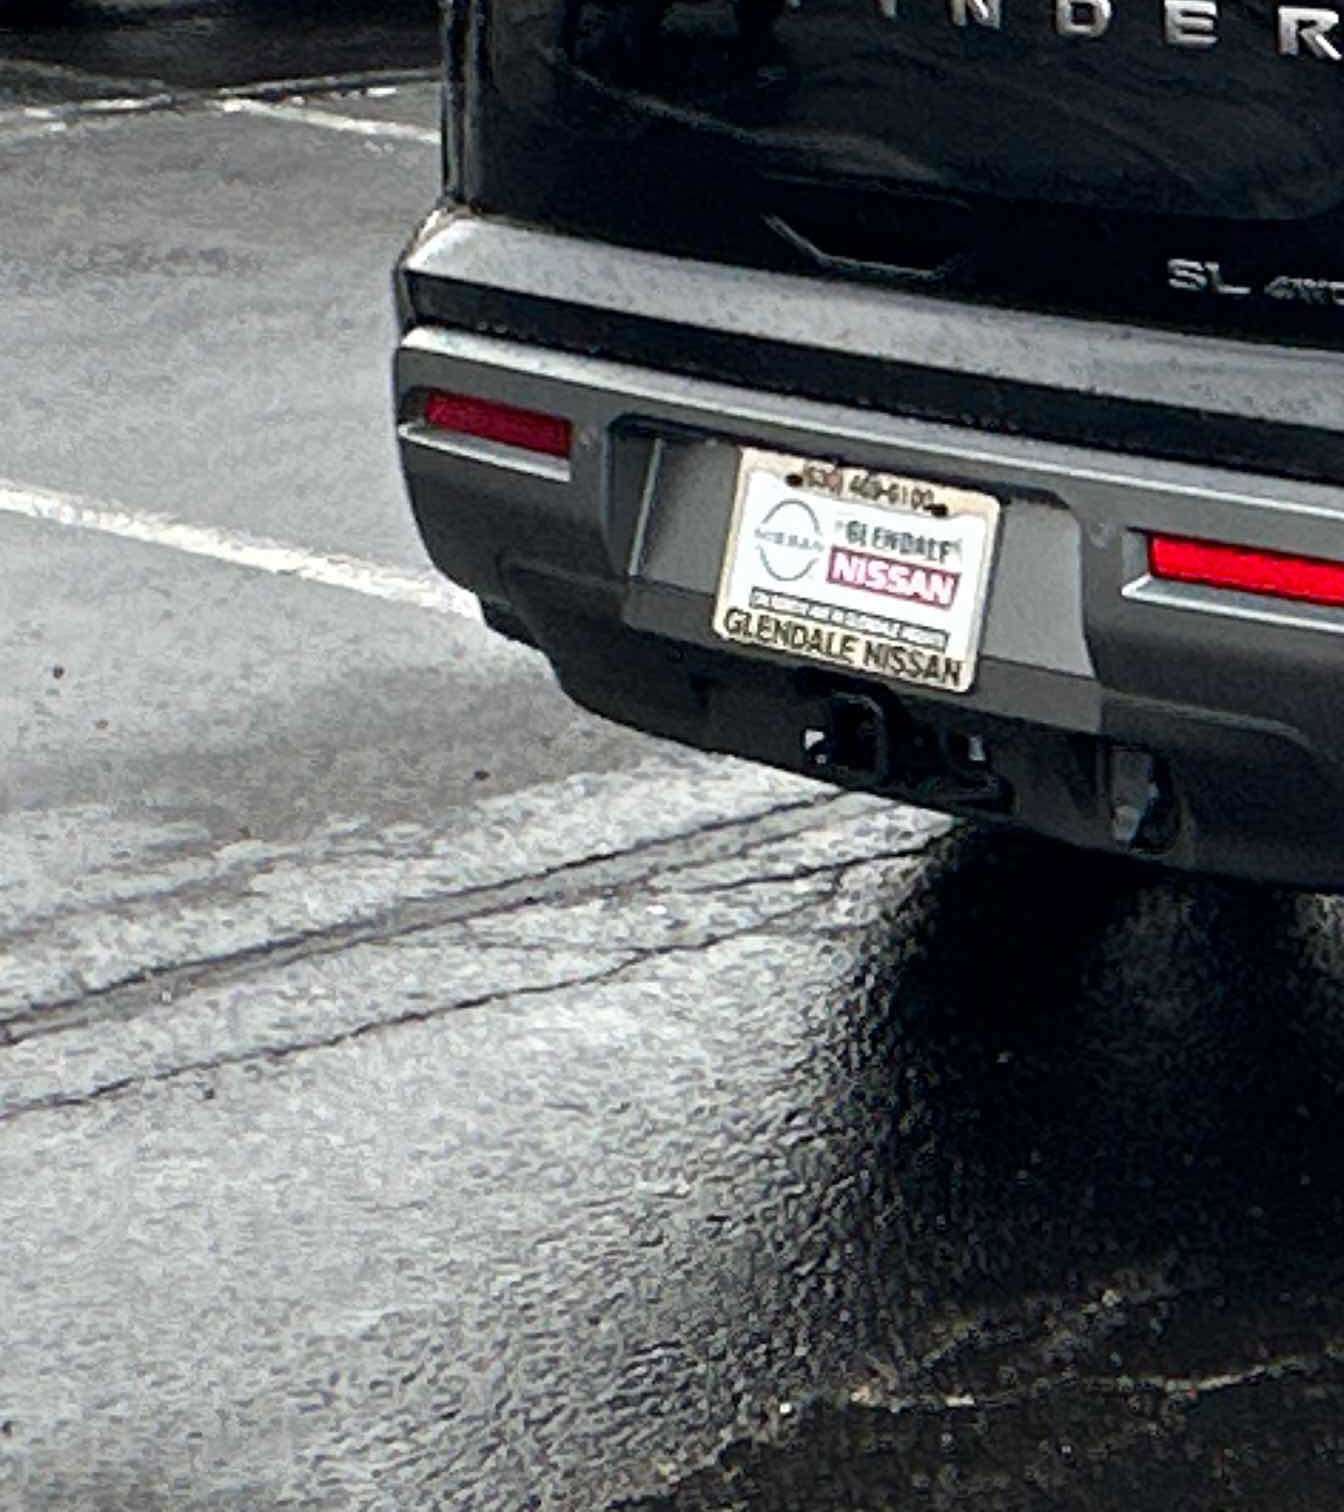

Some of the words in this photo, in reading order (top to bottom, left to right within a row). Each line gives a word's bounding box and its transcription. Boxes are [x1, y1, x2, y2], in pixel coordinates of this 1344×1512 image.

[1168, 259, 1251, 295] SL
[831, 550, 955, 606] NISSAN
[723, 607, 856, 665] GLENDALE
[863, 640, 964, 687] NISSAN
